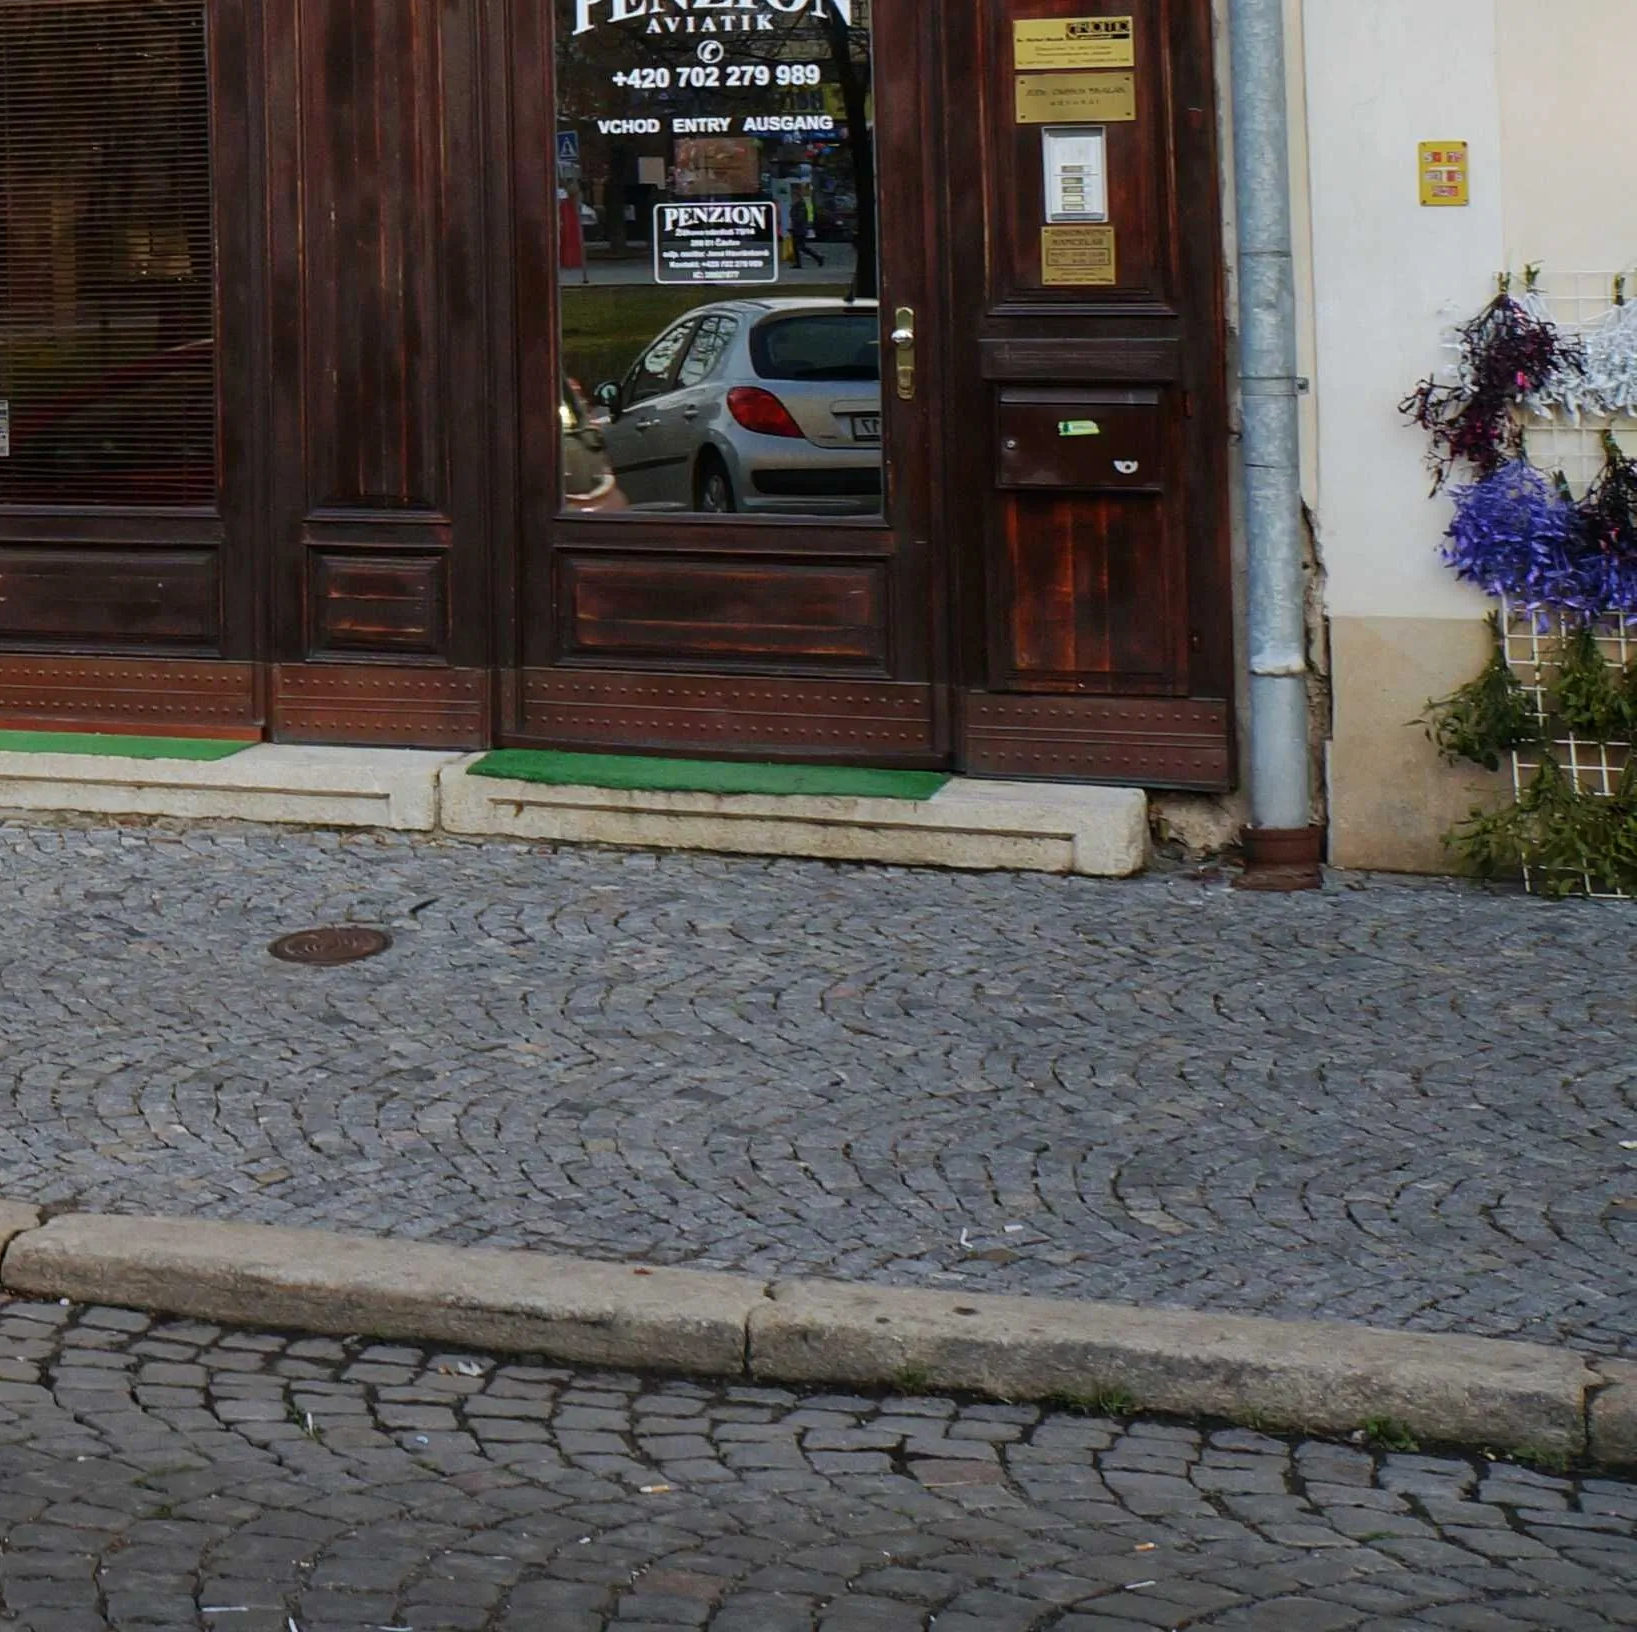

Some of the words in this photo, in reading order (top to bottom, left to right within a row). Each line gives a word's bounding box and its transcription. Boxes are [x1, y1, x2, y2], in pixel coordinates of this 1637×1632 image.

[645, 14, 775, 34] AVIATIK
[612, 67, 671, 90] +420
[676, 66, 720, 89] 702
[724, 65, 769, 88] 279
[775, 63, 821, 87] 989
[597, 118, 660, 135] VCHOD
[672, 116, 731, 134] ENTRY
[742, 114, 834, 133] AUSGANG
[664, 206, 766, 231] PENZION
